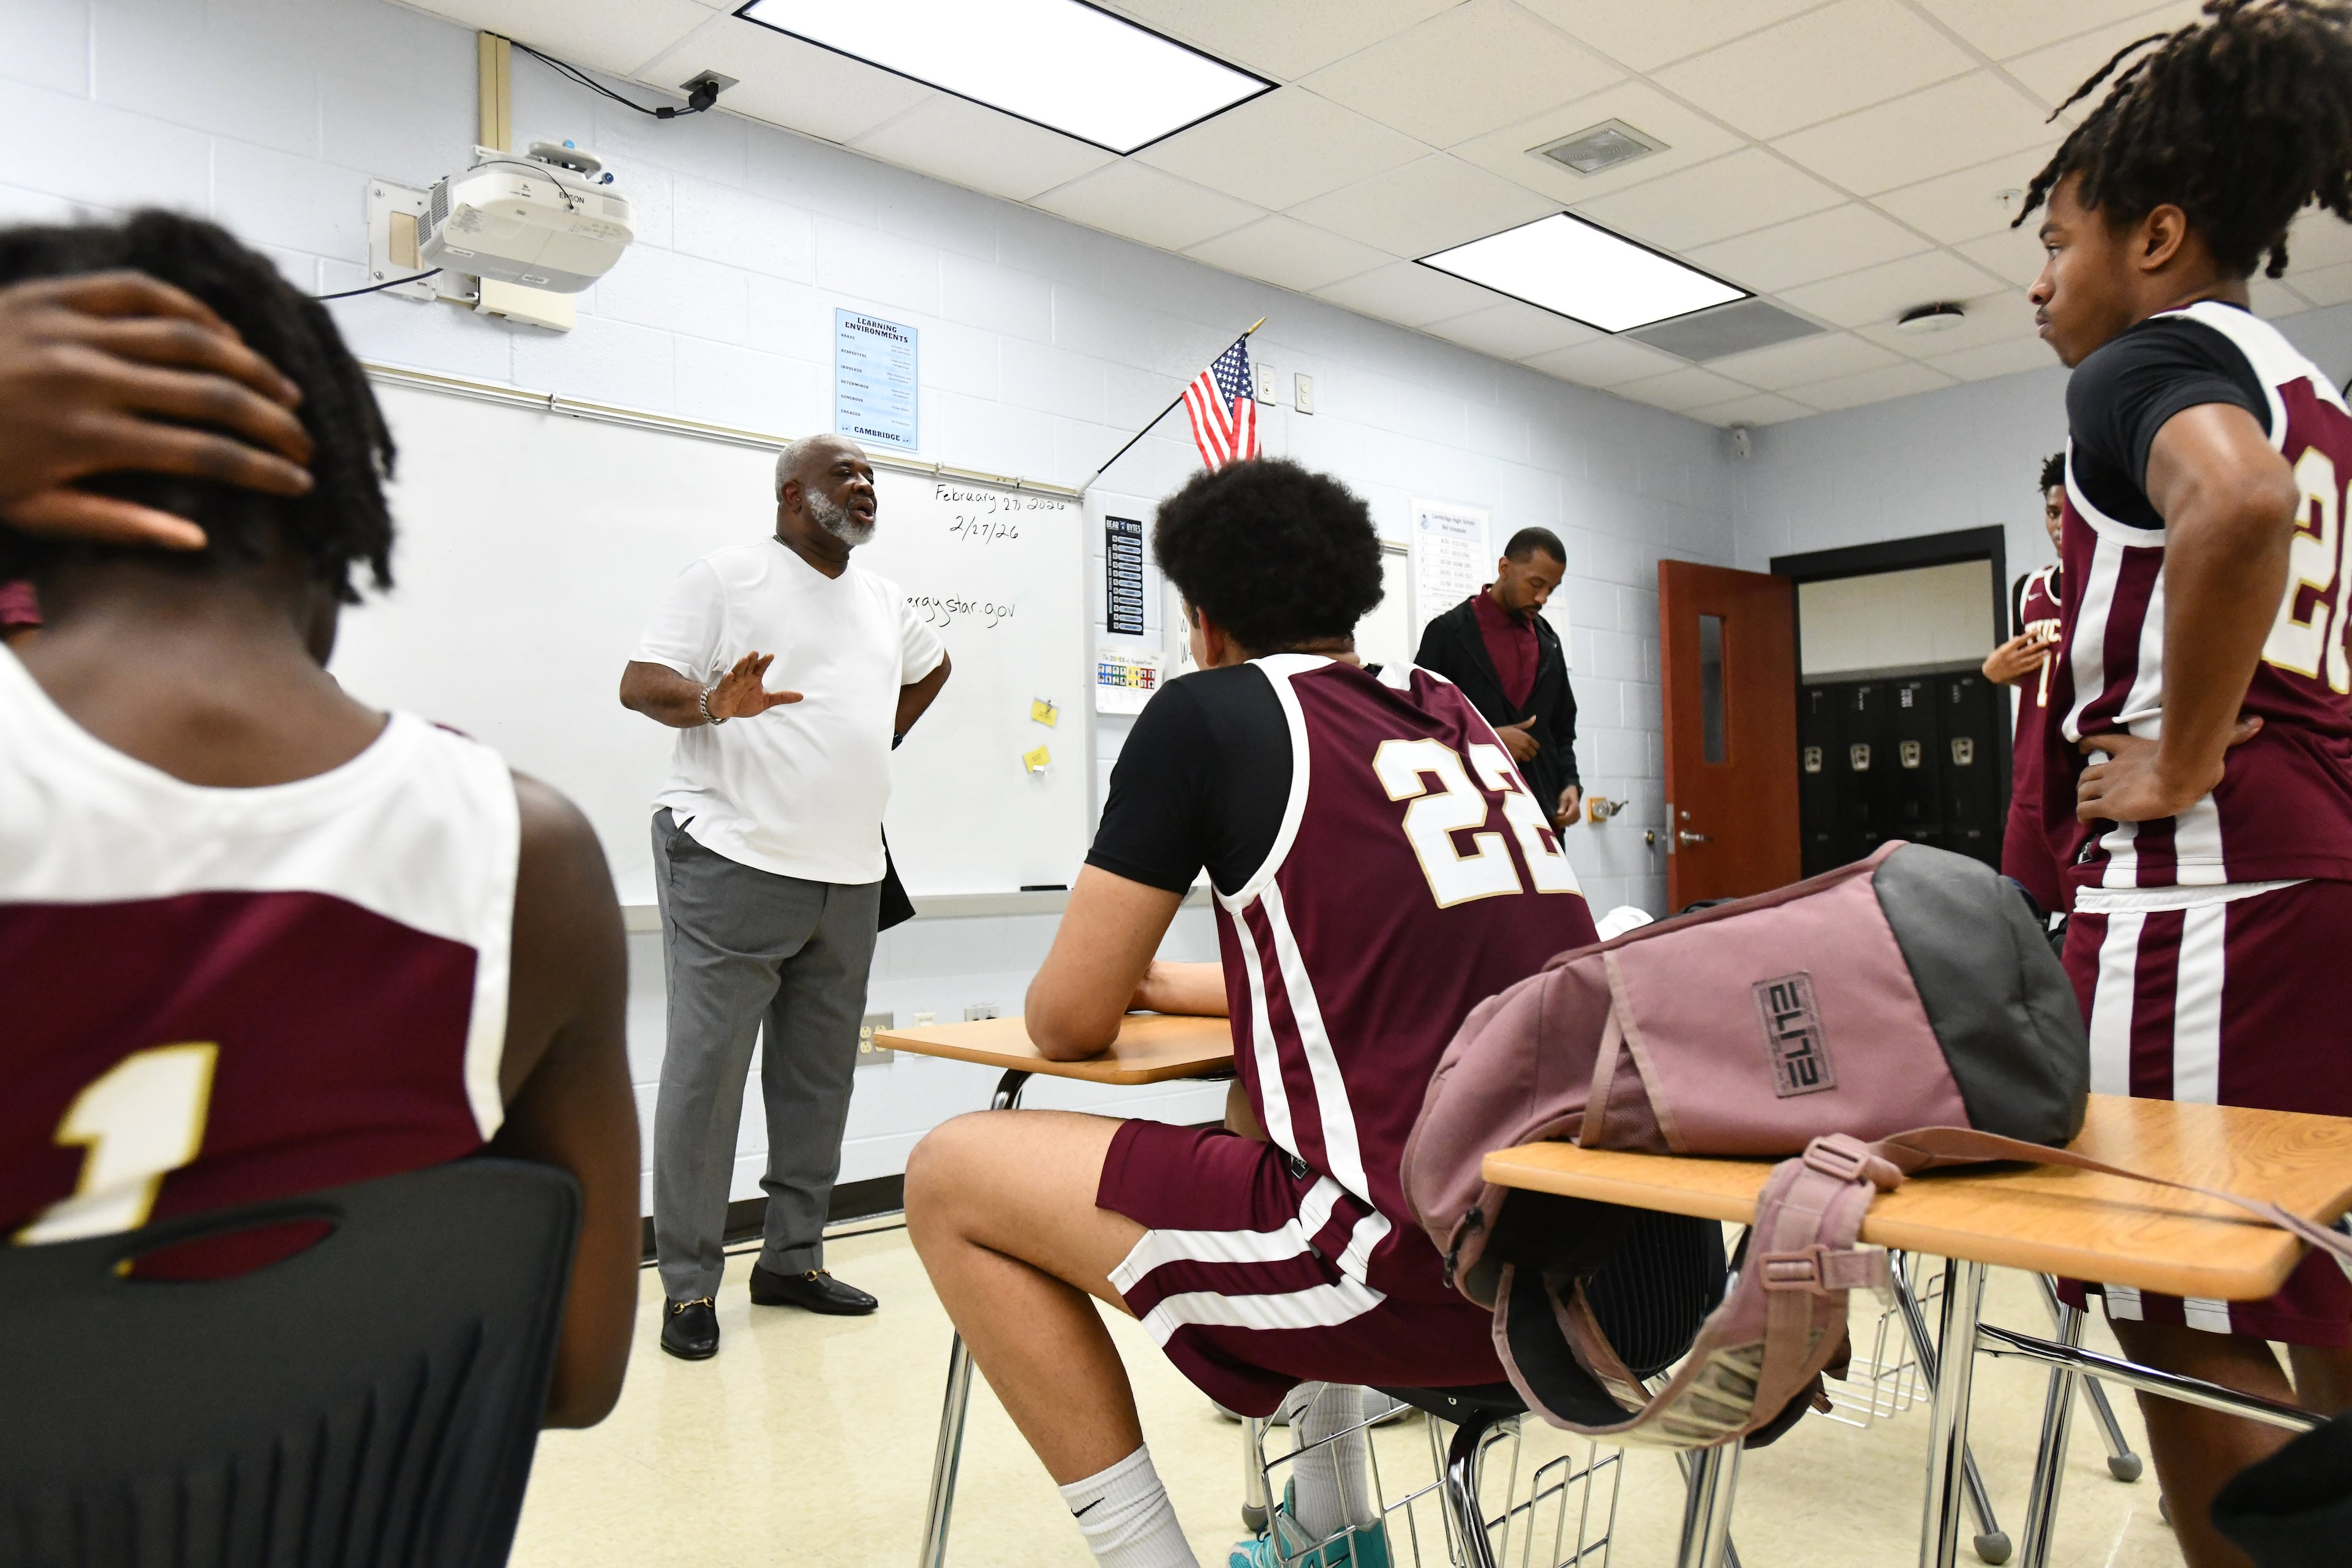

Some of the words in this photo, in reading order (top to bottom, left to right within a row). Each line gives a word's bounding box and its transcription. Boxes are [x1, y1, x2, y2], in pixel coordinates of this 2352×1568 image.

[559, 191, 585, 204] EPSON
[845, 322, 908, 343] ENVIRONMENTS
[858, 317, 897, 333] LEARNING
[841, 349, 867, 358] RESPECTFUL
[841, 364, 862, 373] INVOLVED
[841, 380, 869, 389] DETERMINED
[841, 394, 863, 402] GENEROUS
[854, 426, 900, 441] CAMBRIDGE
[935, 484, 997, 513] February
[1027, 498, 1065, 510] 2026
[949, 516, 1019, 545] 2/27/26
[1106, 519, 1119, 529] BEAR
[1126, 523, 1141, 533] BYTES
[1372, 737, 1586, 910] 22
[11, 1041, 220, 1248] 1
